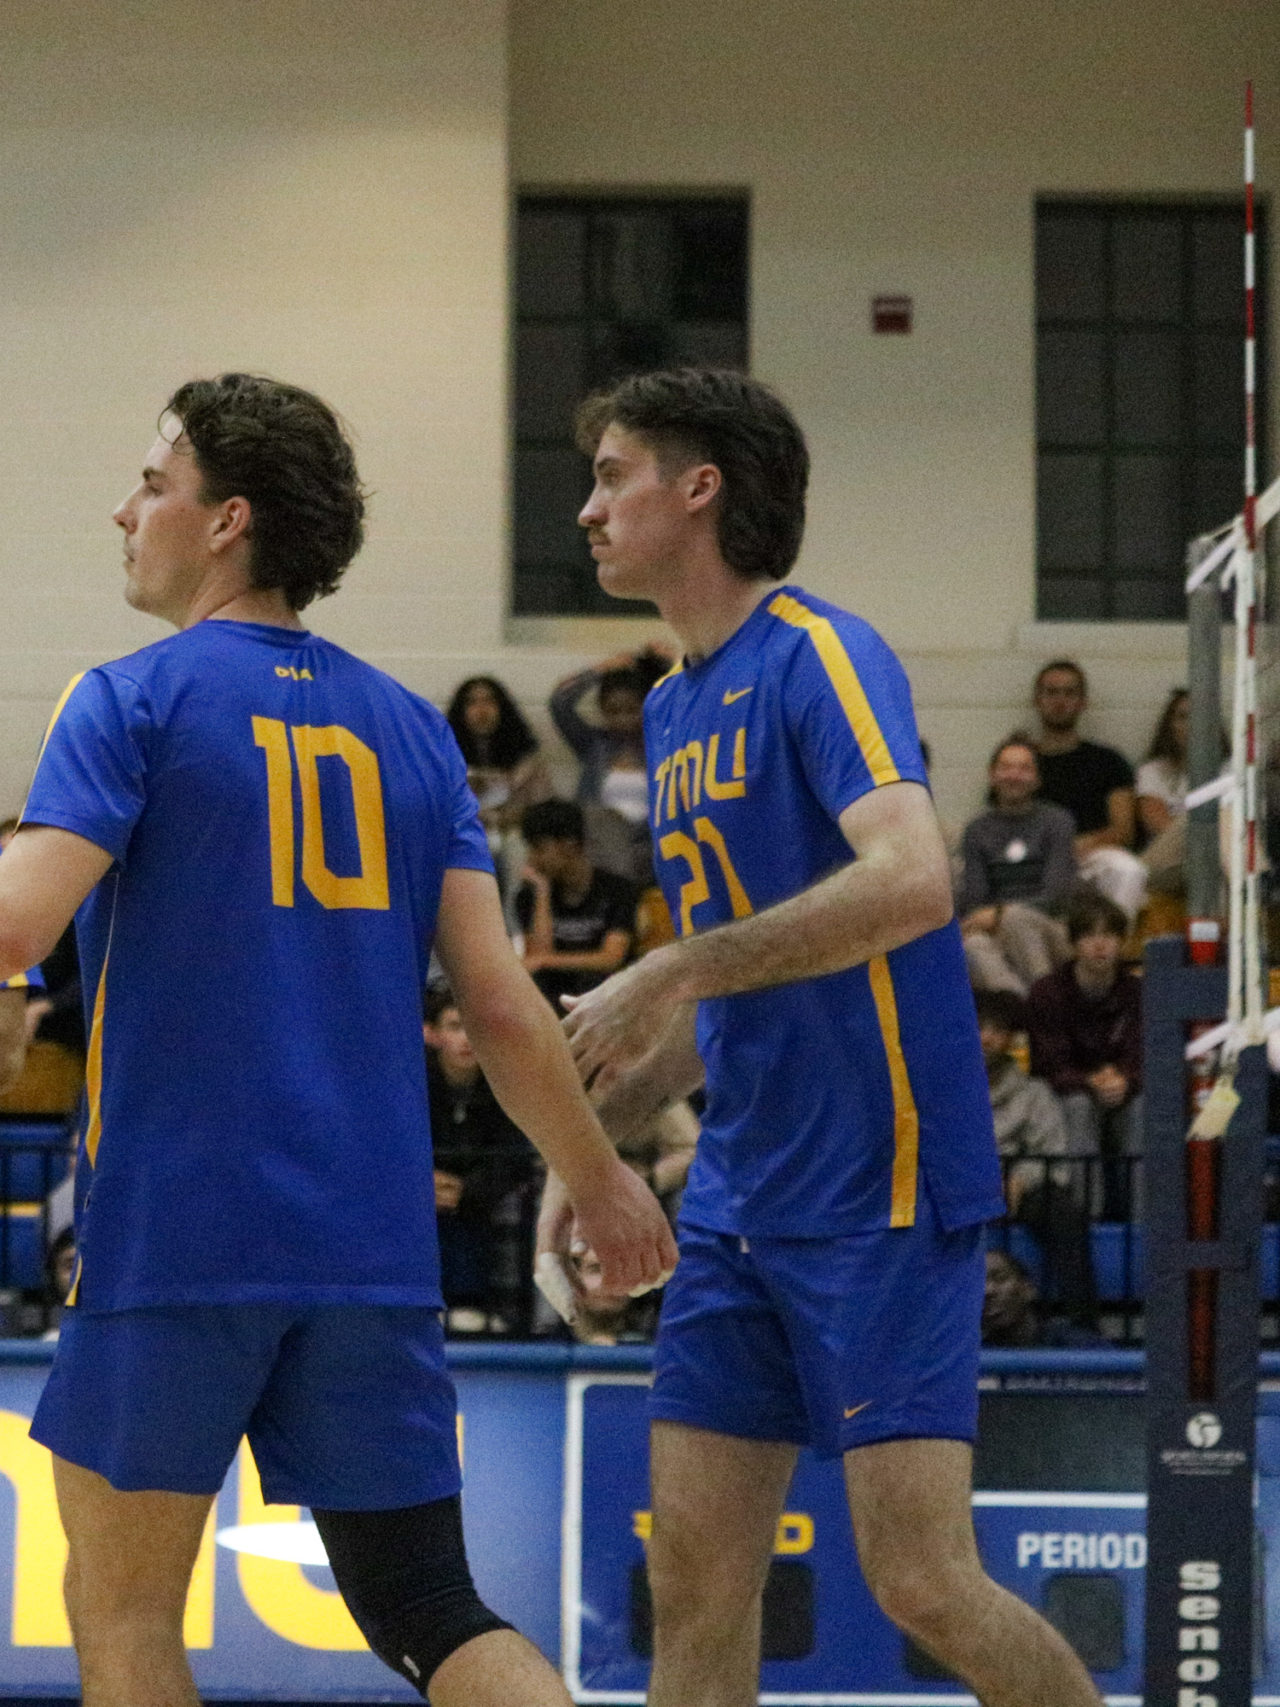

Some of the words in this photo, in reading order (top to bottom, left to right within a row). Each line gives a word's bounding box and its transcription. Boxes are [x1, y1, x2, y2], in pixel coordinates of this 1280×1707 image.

[251, 715, 390, 911] 10
[654, 727, 747, 828] TMU
[1017, 1532, 1148, 1569] PERIOD
